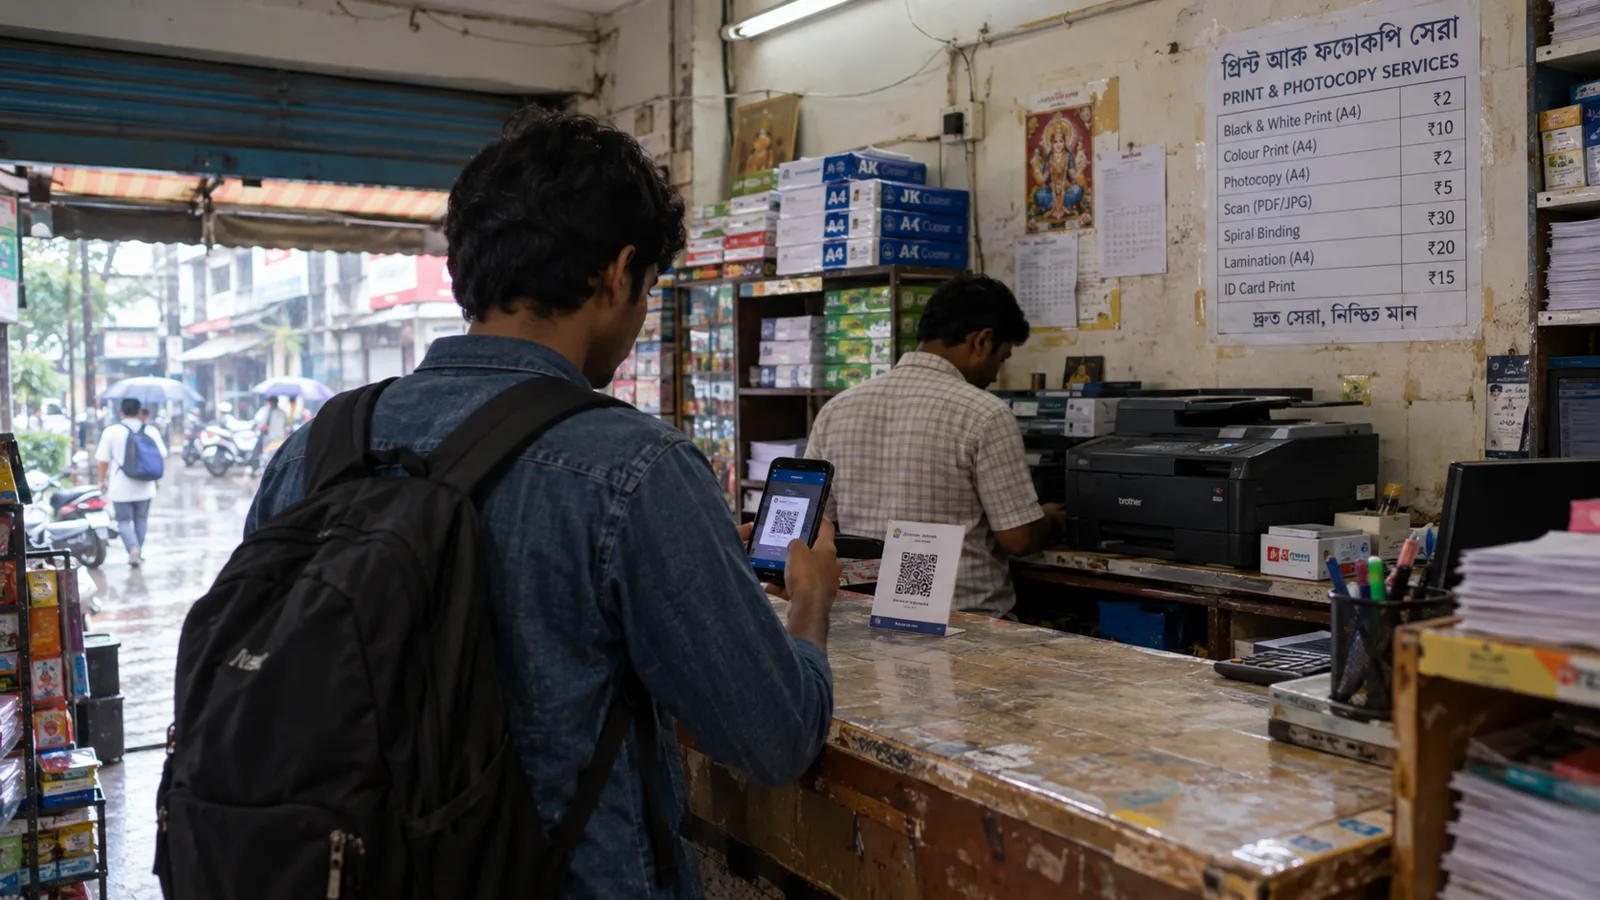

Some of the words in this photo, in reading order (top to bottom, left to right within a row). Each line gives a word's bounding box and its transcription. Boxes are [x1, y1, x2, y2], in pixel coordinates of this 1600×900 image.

[1223, 86, 1264, 106] PRINT
[1269, 84, 1279, 98] &
[1283, 67, 1377, 96] PHOTOCOPY
[1382, 53, 1459, 79] SERVICES
[1433, 91, 1452, 107] ₹2
[1223, 121, 1253, 137] Black
[1256, 120, 1265, 133] &
[1267, 114, 1301, 131] White
[1304, 108, 1332, 126] Print
[1335, 104, 1362, 123] (A4)
[1427, 120, 1454, 137] ₹10
[1223, 147, 1260, 163] Colour
[1263, 141, 1290, 157] Print
[1292, 138, 1317, 156] (A4)
[1433, 150, 1453, 166] ₹2
[1223, 171, 1283, 190] Photocopy
[1285, 167, 1311, 184] (A4)
[1433, 180, 1453, 195] ₹5
[827, 189, 847, 206] A4
[1223, 202, 1250, 216] Scan
[1253, 194, 1312, 213] (PDF/JPG)
[1427, 210, 1455, 226] ₹30
[1223, 228, 1255, 245] Spiral
[1257, 224, 1301, 241] Binding
[825, 247, 844, 263] A4
[1427, 240, 1455, 256] ₹20
[1223, 253, 1286, 269] Lamination
[1289, 250, 1315, 267] (A4)
[1428, 270, 1455, 285] ₹15
[1224, 282, 1237, 295] ID
[1239, 280, 1266, 295] Card
[1268, 280, 1296, 293] Print
[1385, 304, 1418, 322] মান
